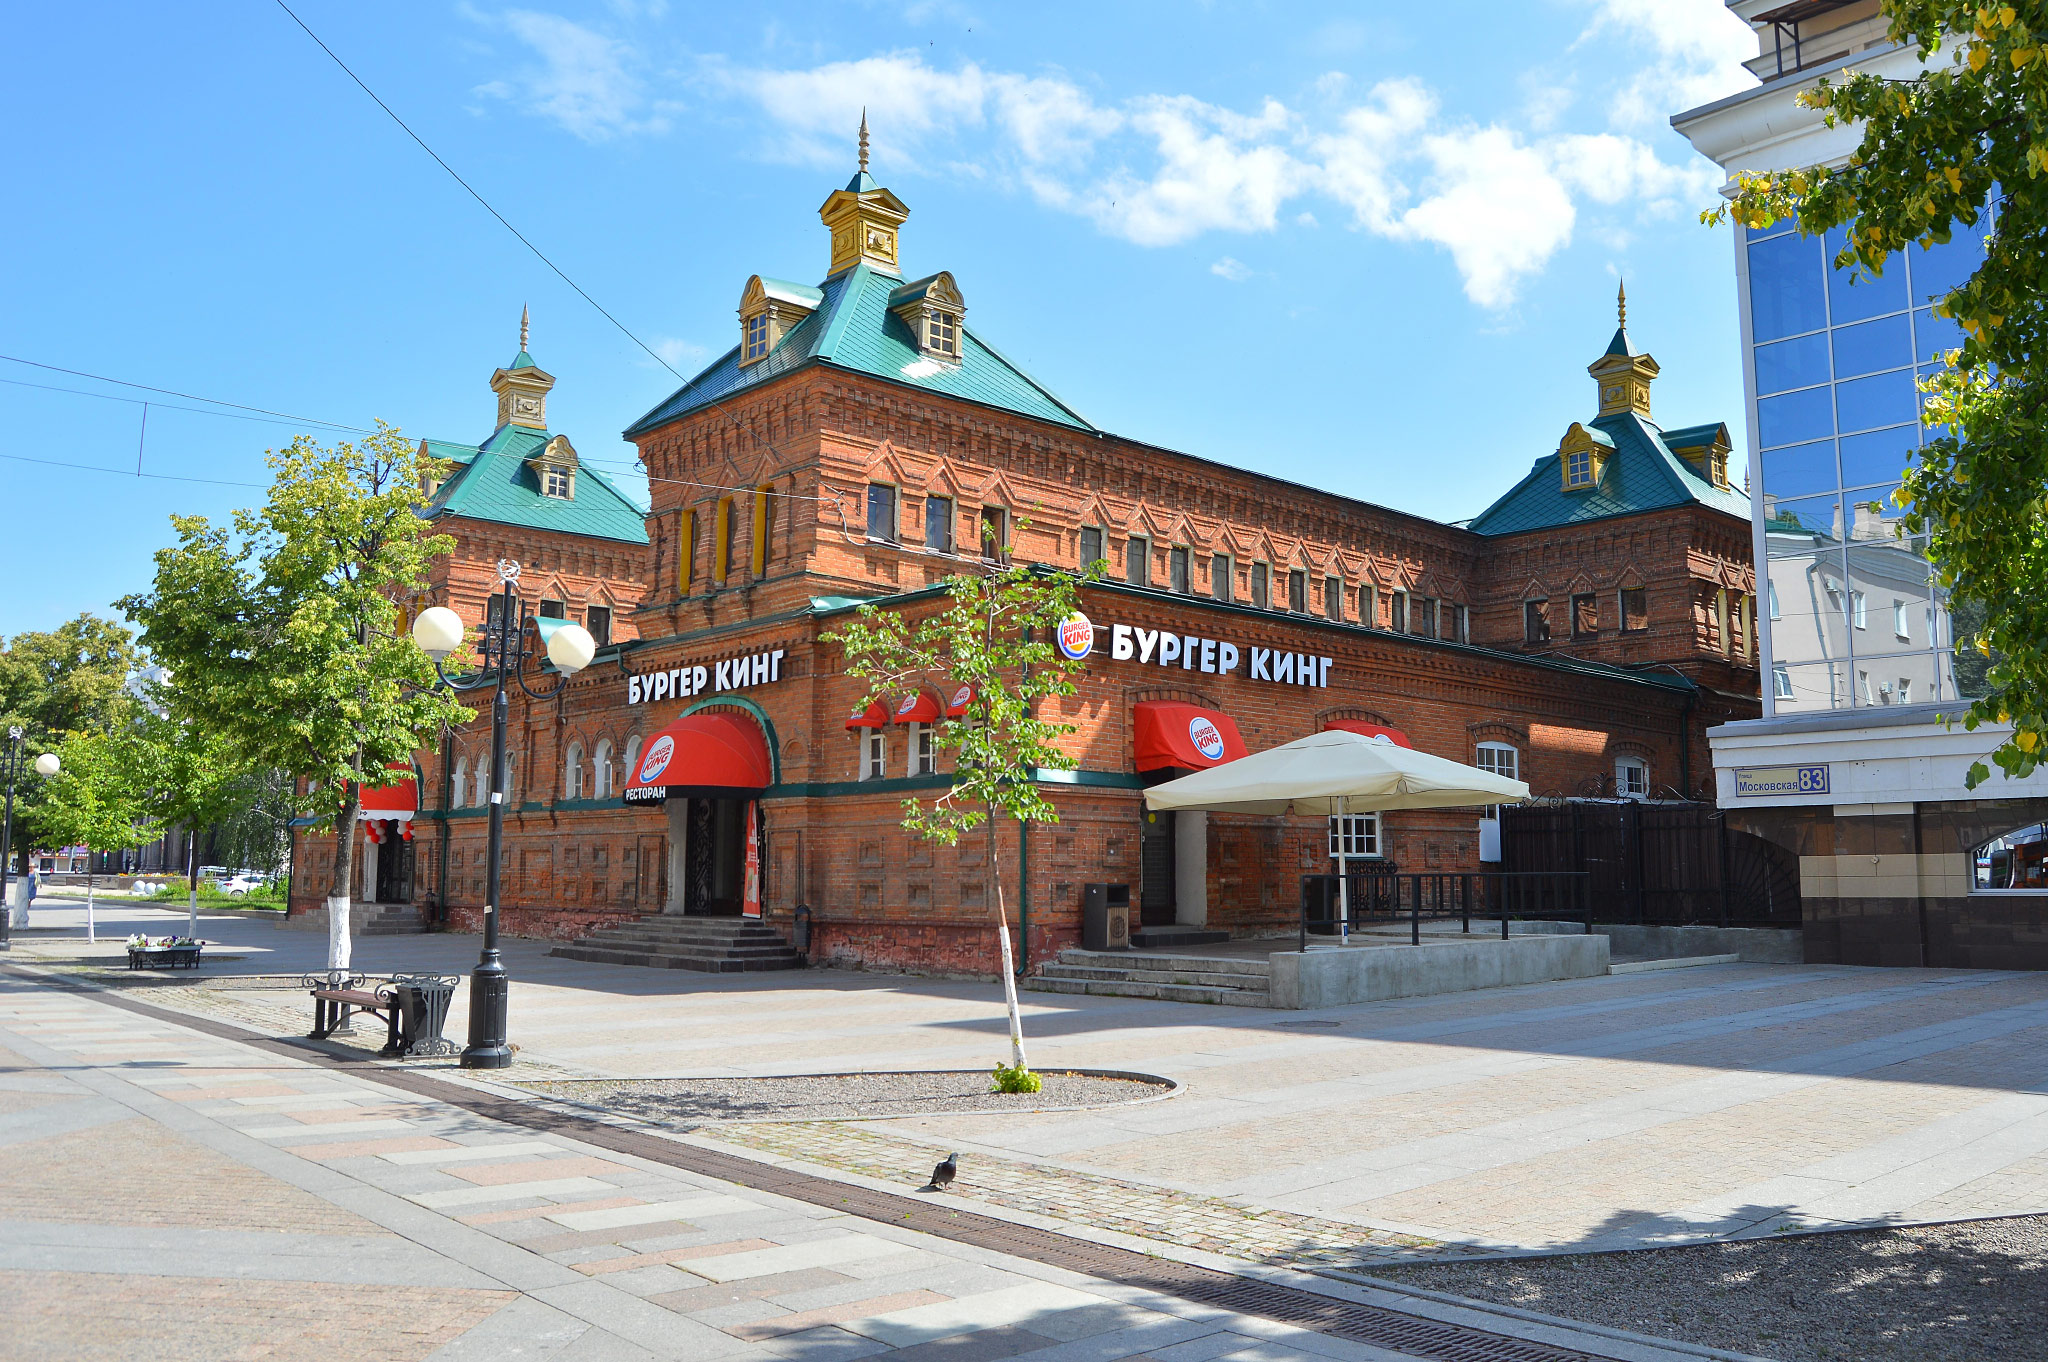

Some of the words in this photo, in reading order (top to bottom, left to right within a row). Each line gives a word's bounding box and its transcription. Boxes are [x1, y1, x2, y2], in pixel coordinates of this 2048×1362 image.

[1063, 621, 1089, 635] BURGER
[1064, 629, 1090, 647] KING
[1112, 623, 1239, 675] БУРГЕР
[1251, 646, 1333, 688] КИНГ
[628, 665, 708, 705] БУРГЕР
[715, 649, 784, 692] КИНГ
[1193, 725, 1215, 740] BURGER
[1197, 733, 1219, 750] KING
[642, 751, 670, 774] KING
[1739, 781, 1798, 792] Московская
[1800, 769, 1824, 790] 83
[625, 785, 666, 801] РЕСТОРАН
